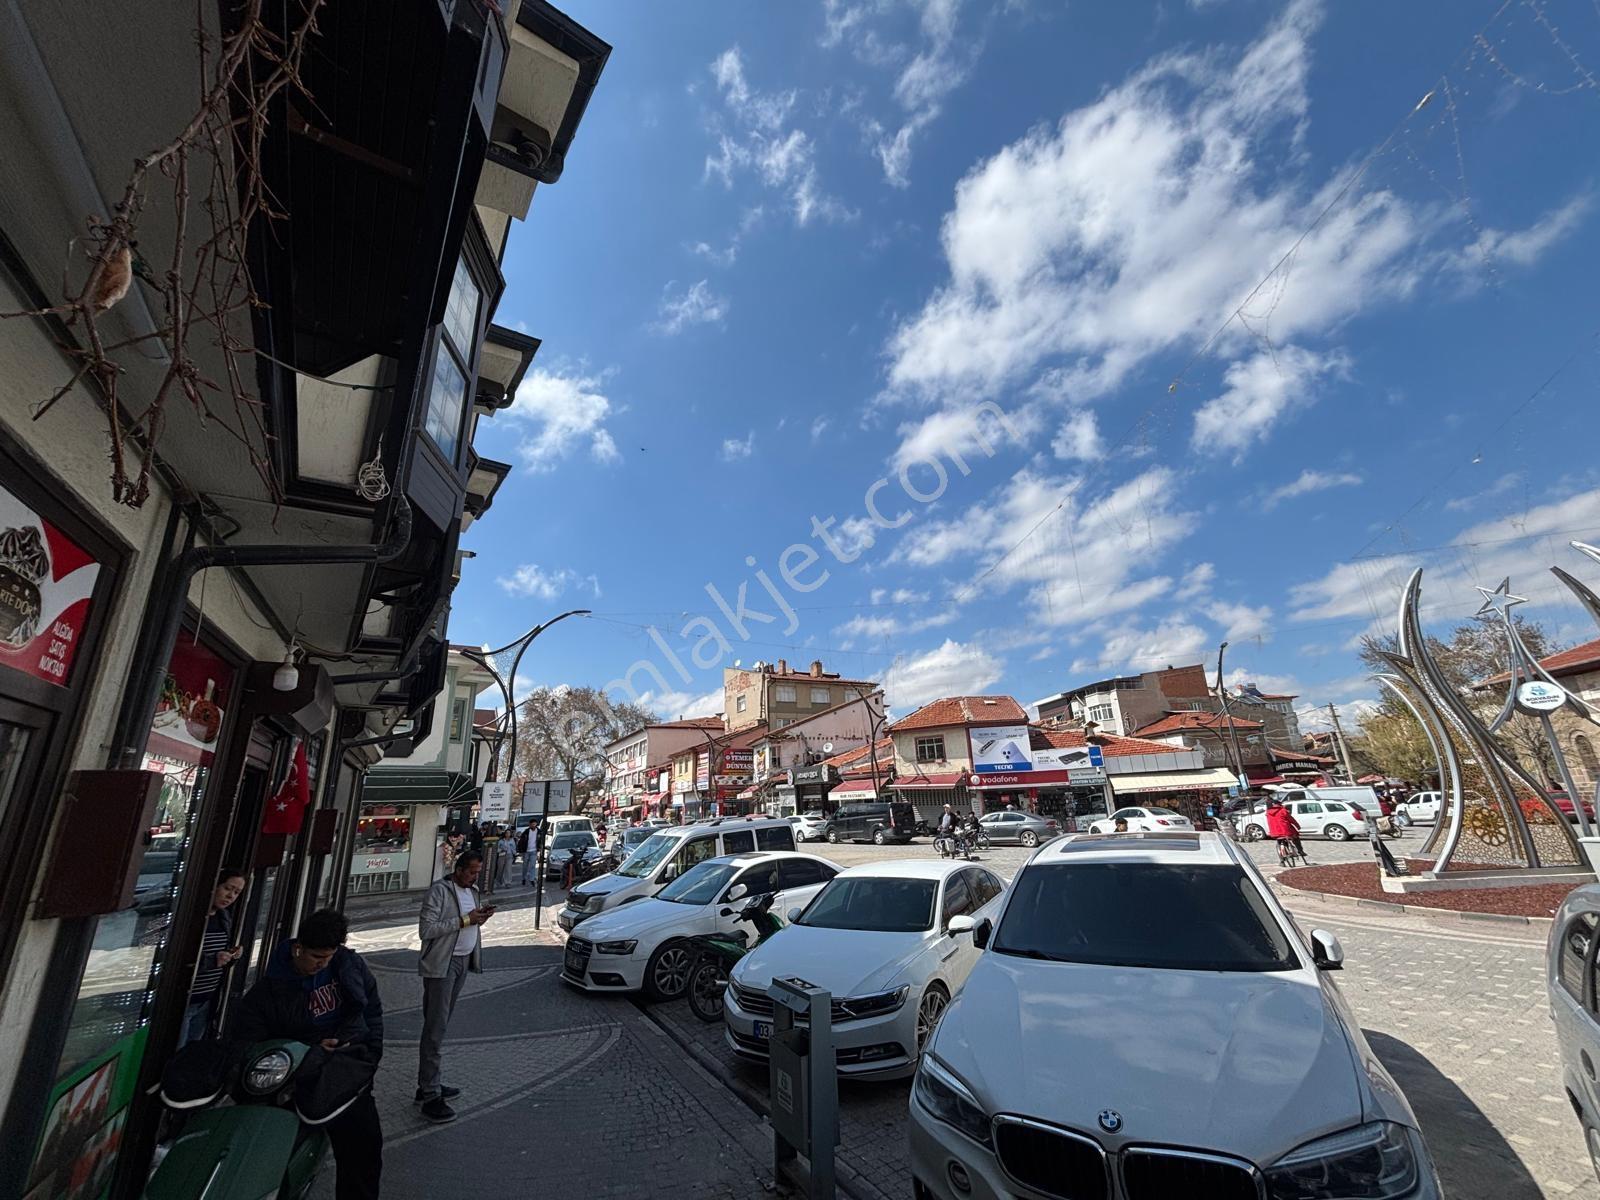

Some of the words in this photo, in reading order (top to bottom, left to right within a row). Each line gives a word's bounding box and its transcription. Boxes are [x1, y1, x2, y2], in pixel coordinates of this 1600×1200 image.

[48, 639, 67, 660] SATIŞ
[39, 655, 65, 677] NOKTASI
[982, 775, 1018, 783] vodafone
[366, 857, 390, 868] Waffle
